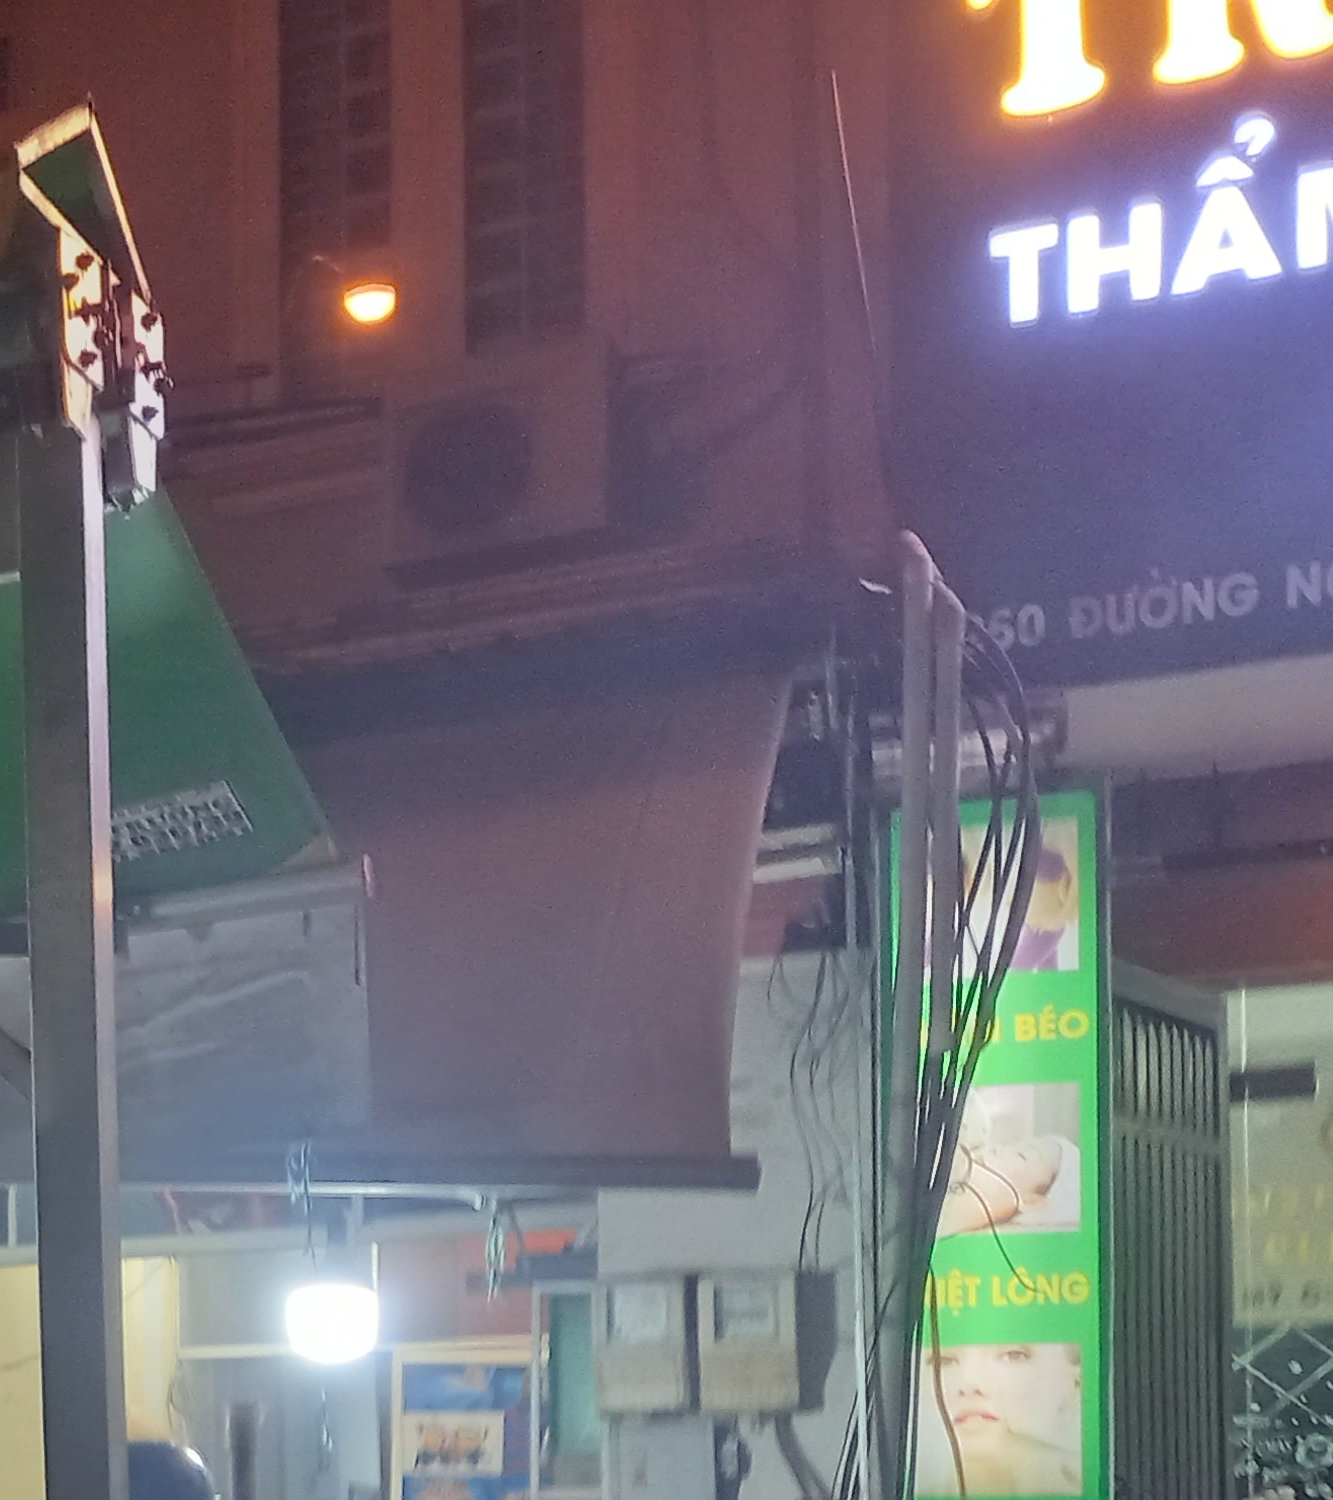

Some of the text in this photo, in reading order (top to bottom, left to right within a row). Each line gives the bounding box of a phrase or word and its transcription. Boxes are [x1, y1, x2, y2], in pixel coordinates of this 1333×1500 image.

[1286, 562, 1333, 610] N
[1014, 1003, 1090, 1042] BÉO
[991, 1265, 1091, 1307] LÔNG
